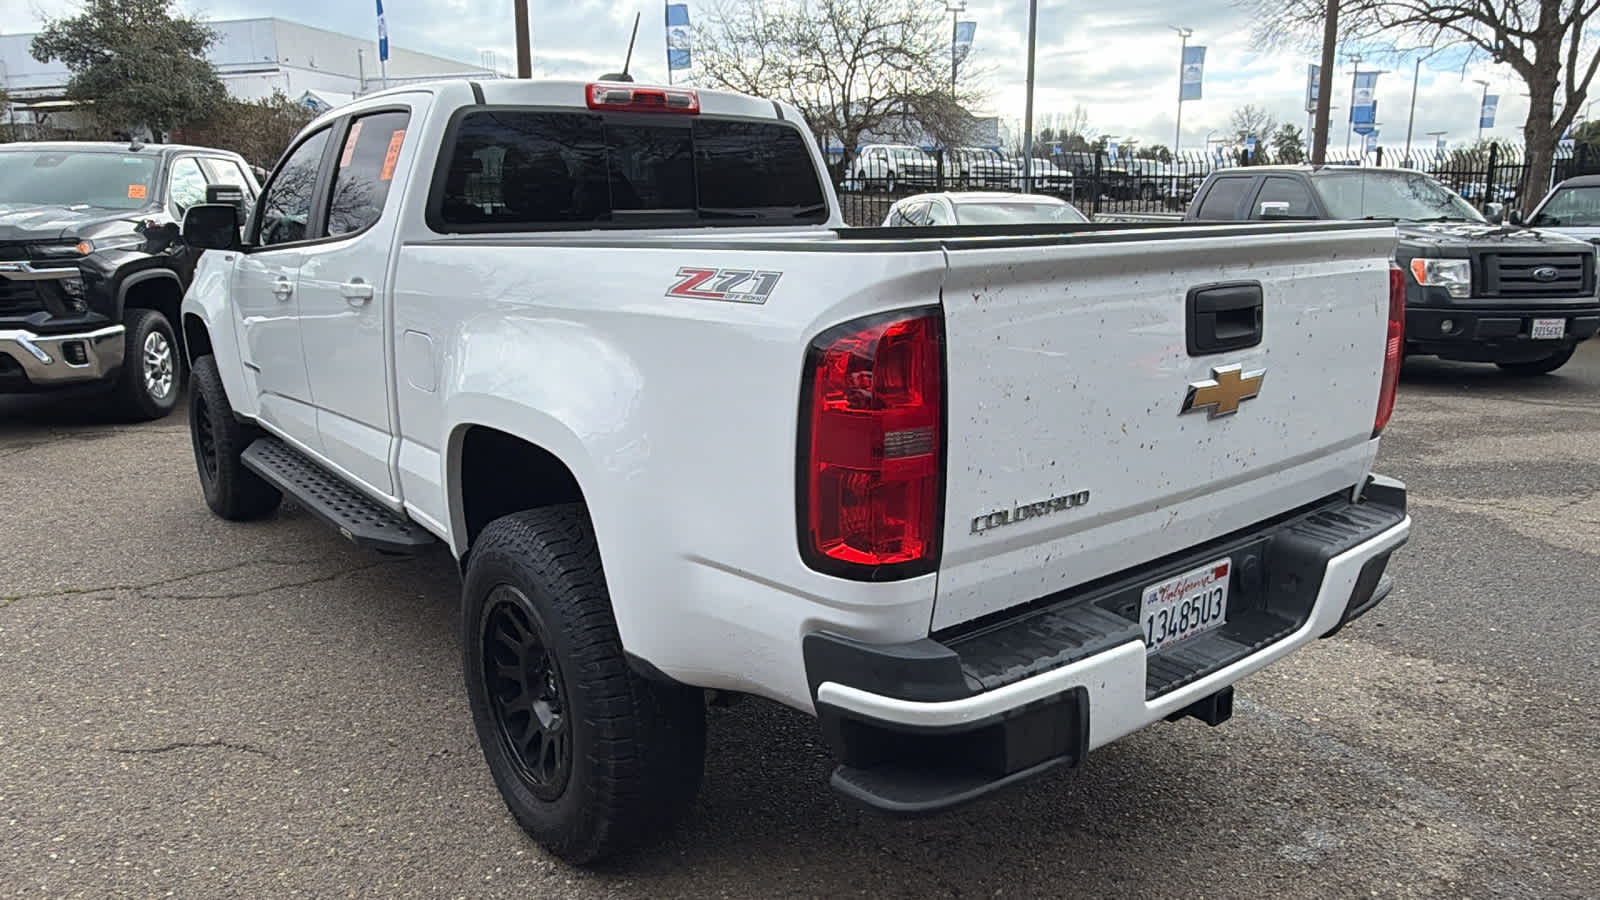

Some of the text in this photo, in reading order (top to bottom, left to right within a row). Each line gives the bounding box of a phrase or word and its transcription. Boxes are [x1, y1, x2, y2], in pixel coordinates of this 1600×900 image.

[665, 267, 783, 304] Z71
[971, 490, 1090, 533] COLORADO
[1160, 575, 1214, 603] California
[1146, 587, 1223, 649] 13485U3
